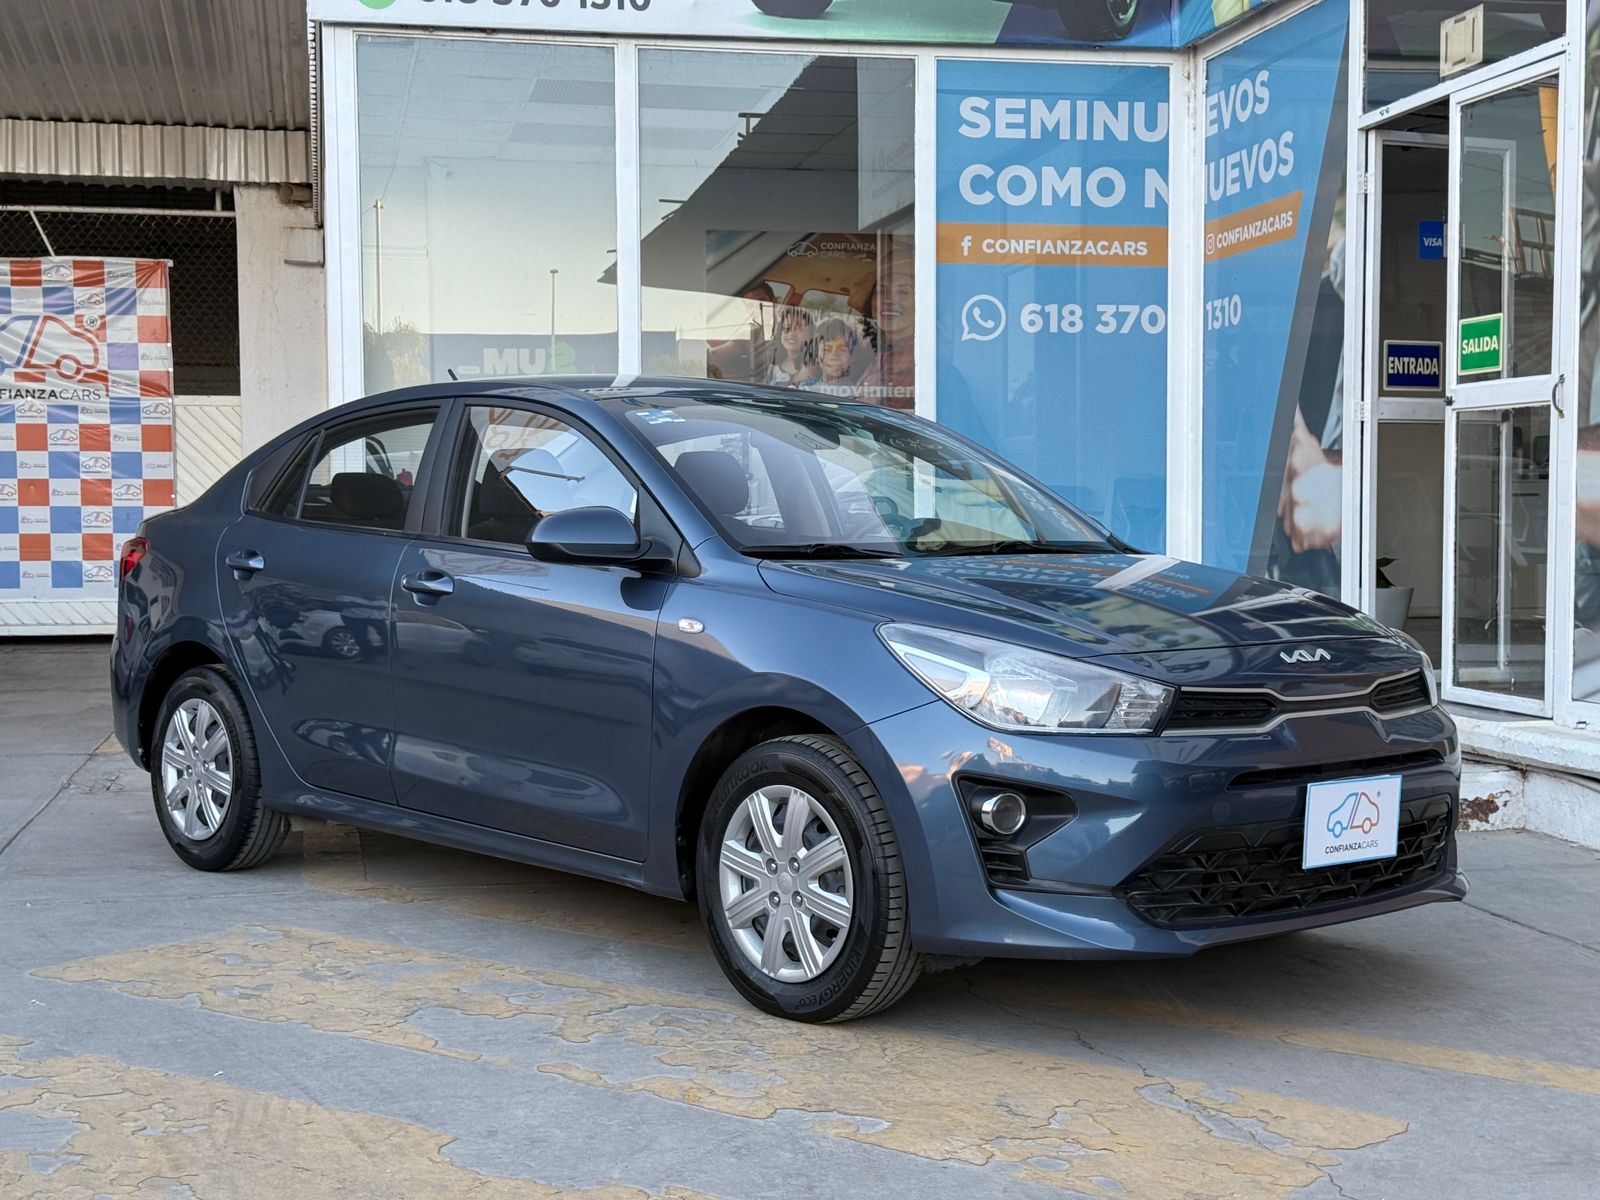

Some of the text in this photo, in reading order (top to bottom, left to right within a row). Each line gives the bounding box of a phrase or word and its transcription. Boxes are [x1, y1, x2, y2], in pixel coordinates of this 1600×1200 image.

[1205, 69, 1270, 138] EVOS
[958, 96, 1168, 143] SEMINU
[1204, 130, 1294, 205] UEVOS
[959, 163, 1126, 208] COMO
[1216, 211, 1293, 249] CONFIANZACARS
[1423, 237, 1442, 247] VISA
[820, 242, 877, 251] CONFIANZA
[982, 238, 1148, 256] CONFIANZACARS
[1020, 303, 1166, 334] 618 370
[1206, 294, 1241, 331] 1310
[1462, 335, 1498, 354] SALIDA
[1388, 356, 1439, 375] ENTRADA
[1325, 840, 1378, 855] CONFIANZACARS
